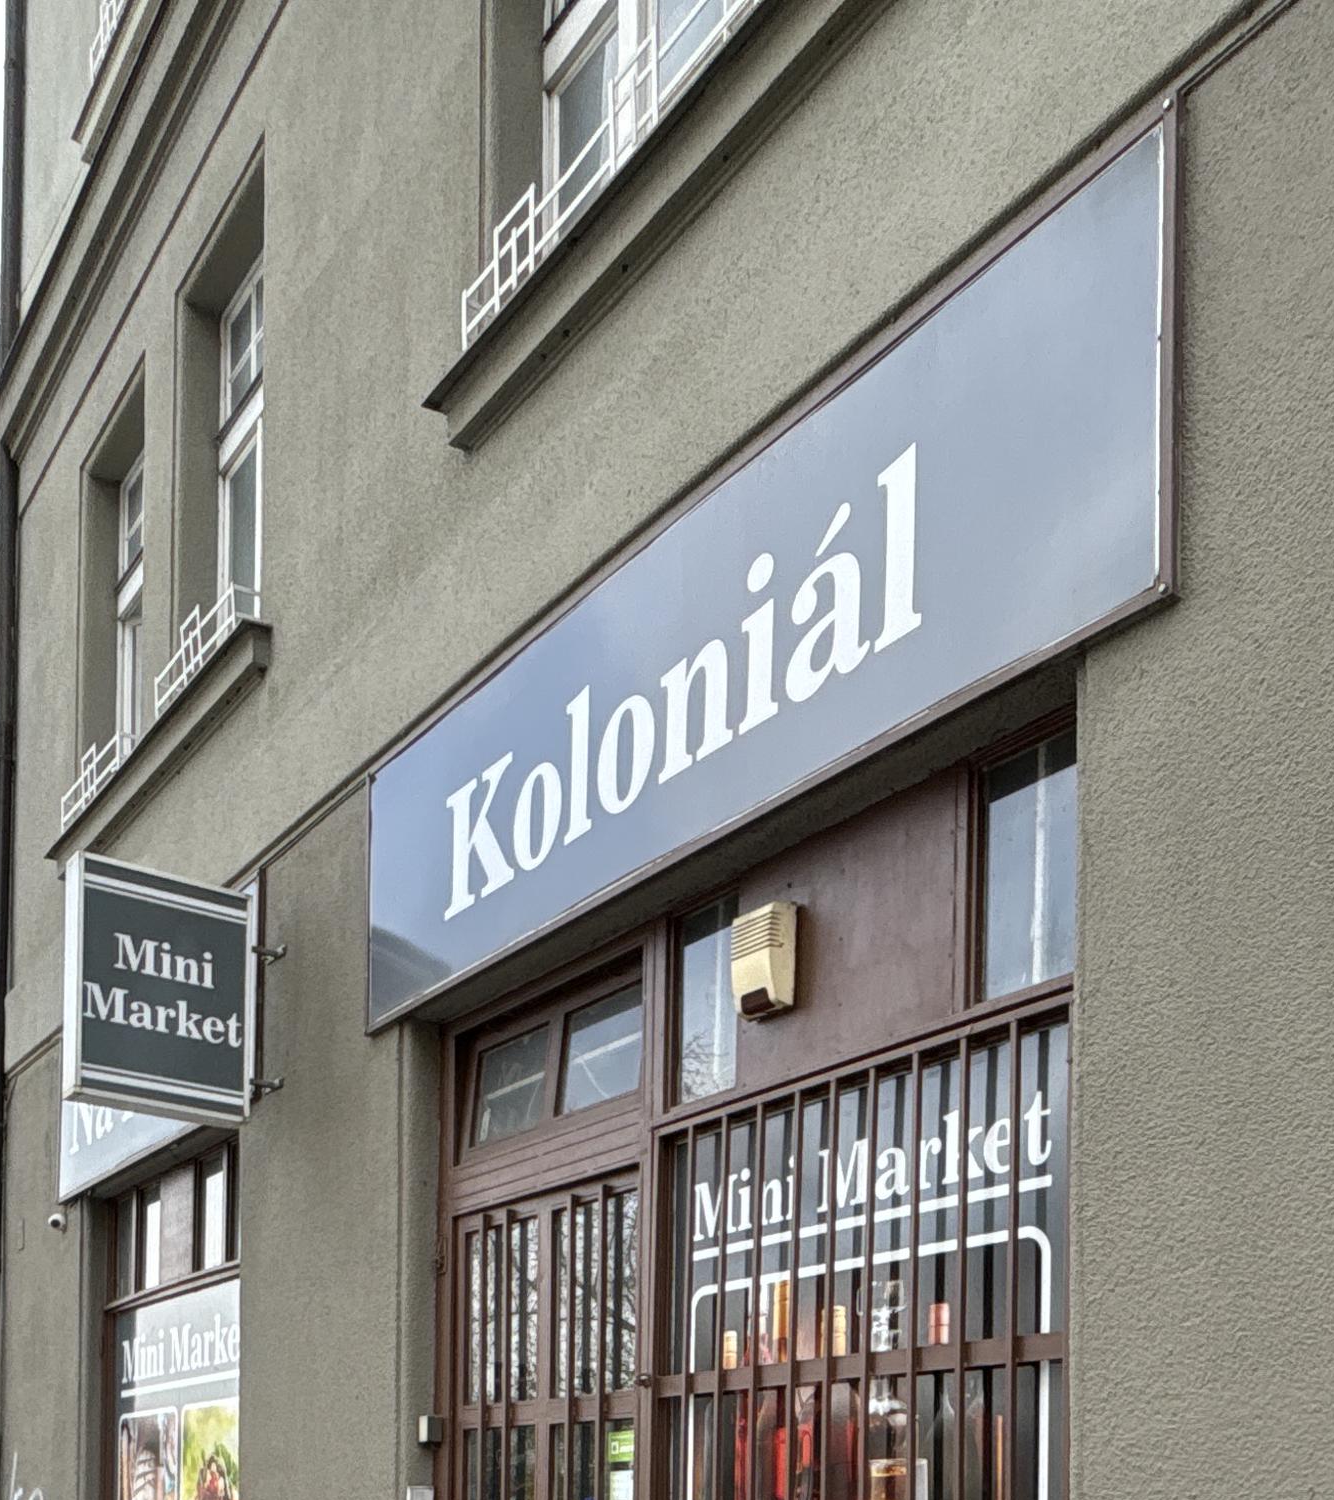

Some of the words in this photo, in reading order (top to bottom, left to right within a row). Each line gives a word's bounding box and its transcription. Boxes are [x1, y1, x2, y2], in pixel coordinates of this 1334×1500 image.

[444, 442, 922, 921] Koloniál
[113, 931, 216, 989] Mini
[83, 981, 243, 1048] Market
[693, 1154, 795, 1242] Mini
[816, 1090, 1053, 1214] Market
[121, 1328, 165, 1384] Mini
[169, 1313, 240, 1375] Marke
